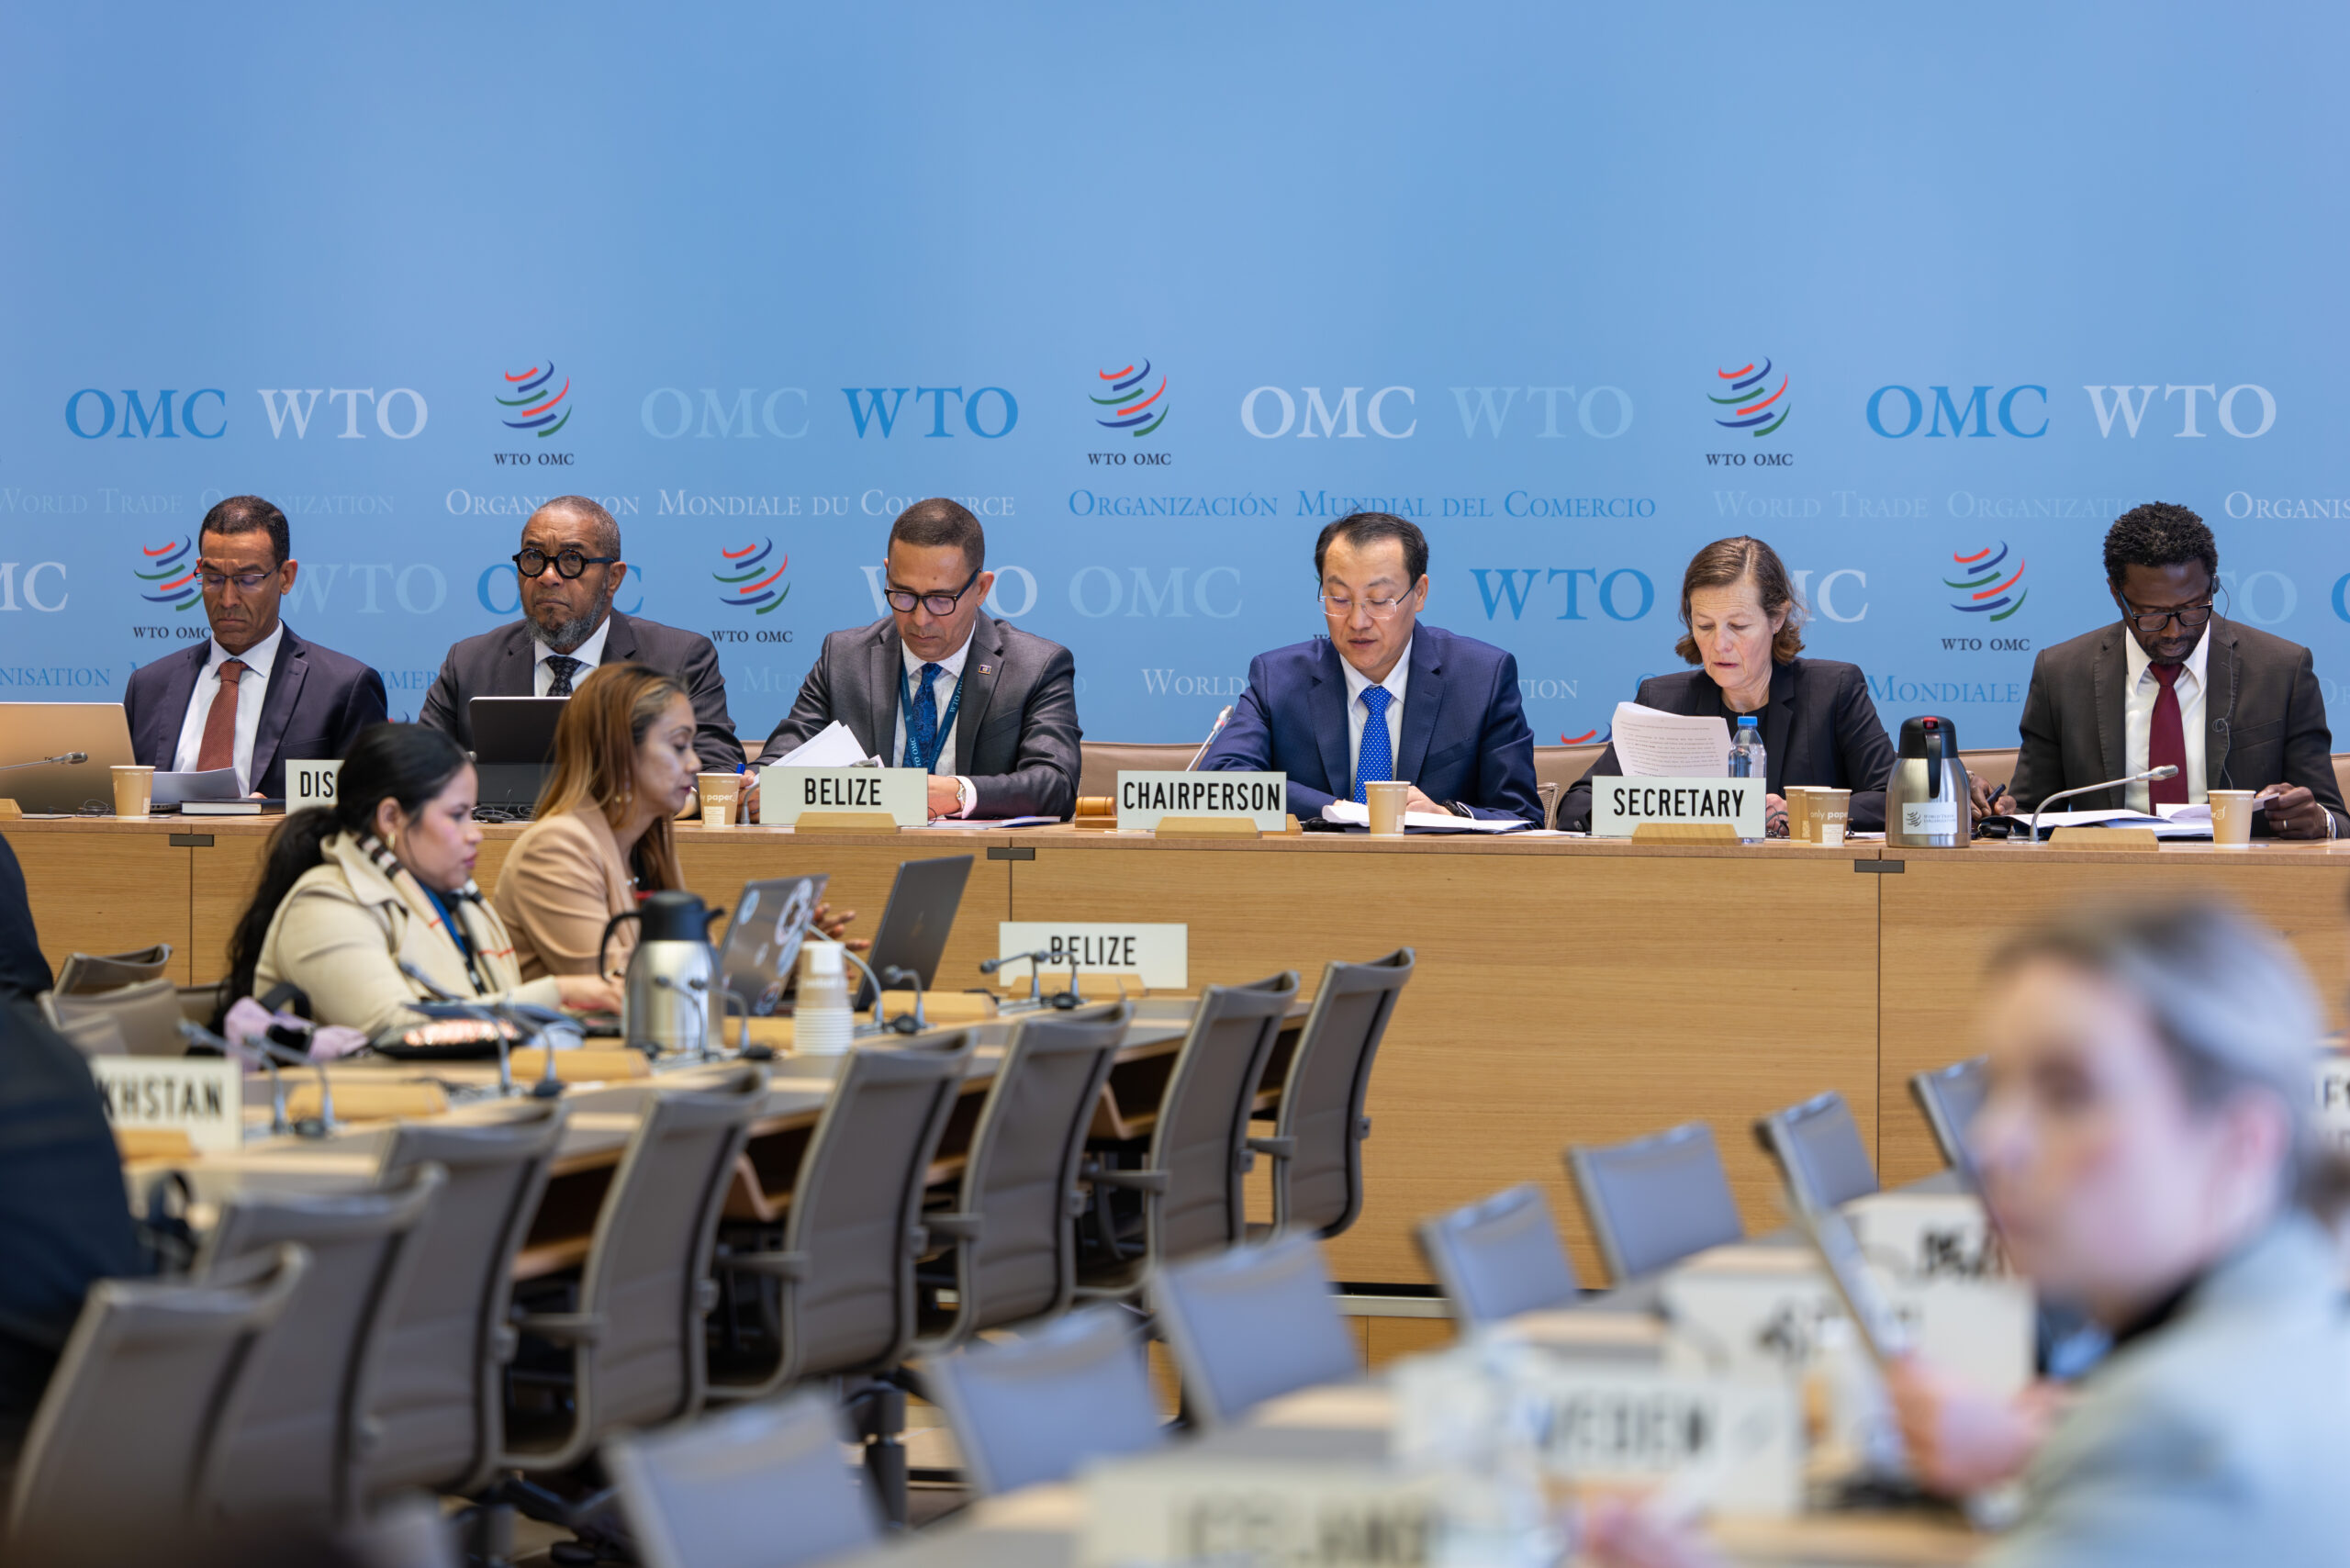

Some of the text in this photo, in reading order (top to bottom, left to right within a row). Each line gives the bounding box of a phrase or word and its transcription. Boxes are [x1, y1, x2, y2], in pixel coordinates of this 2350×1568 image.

[65, 387, 429, 440] OMC WTO
[642, 386, 1019, 440] OMC WTO
[1240, 386, 1634, 440] OMC WTO
[1865, 384, 2277, 440] OMC WTO
[494, 453, 575, 465] WTO OMC
[1088, 453, 1171, 465] WTO OMC
[1706, 454, 1794, 466] WTO OMC
[288, 564, 447, 614] WTO
[1069, 566, 1243, 619] OMC
[1469, 567, 1656, 622] WTO
[133, 626, 211, 639] WTO OMC
[711, 630, 793, 644] WTO OMC
[1942, 638, 2030, 651] WTO OMC
[300, 771, 334, 798] DIS
[804, 778, 882, 806] BELIZE
[1124, 781, 1281, 811] CHAIRPERSON
[1613, 788, 1744, 816] SECRETARY
[1050, 935, 1136, 966] BELIZE
